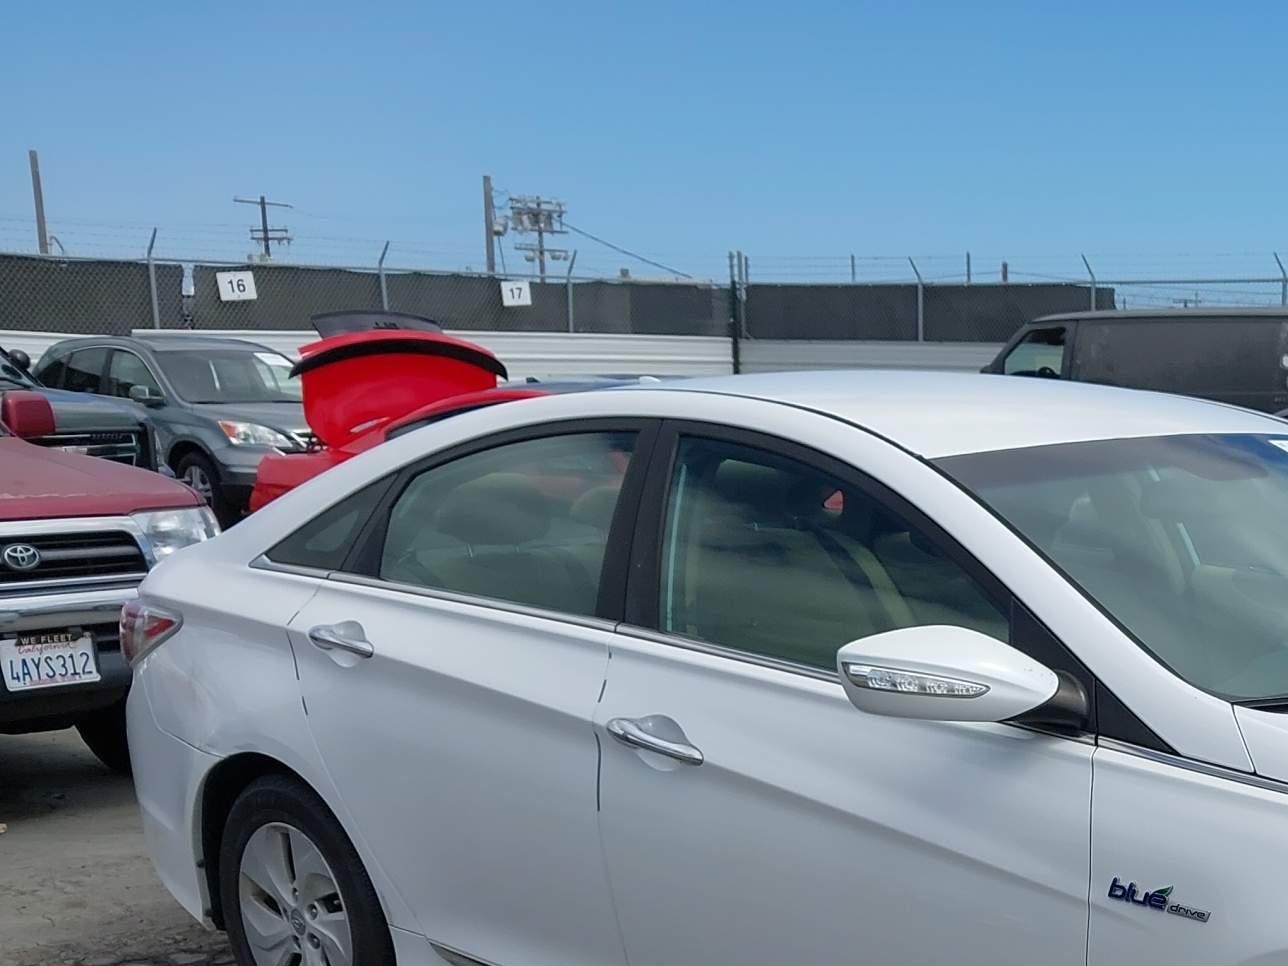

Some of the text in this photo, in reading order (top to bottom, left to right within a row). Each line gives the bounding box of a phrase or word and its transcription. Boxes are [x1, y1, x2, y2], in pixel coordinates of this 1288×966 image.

[227, 278, 246, 293] 16
[509, 287, 522, 300] 17
[9, 651, 93, 683] 4AYS312
[1107, 876, 1206, 919] blue drive
